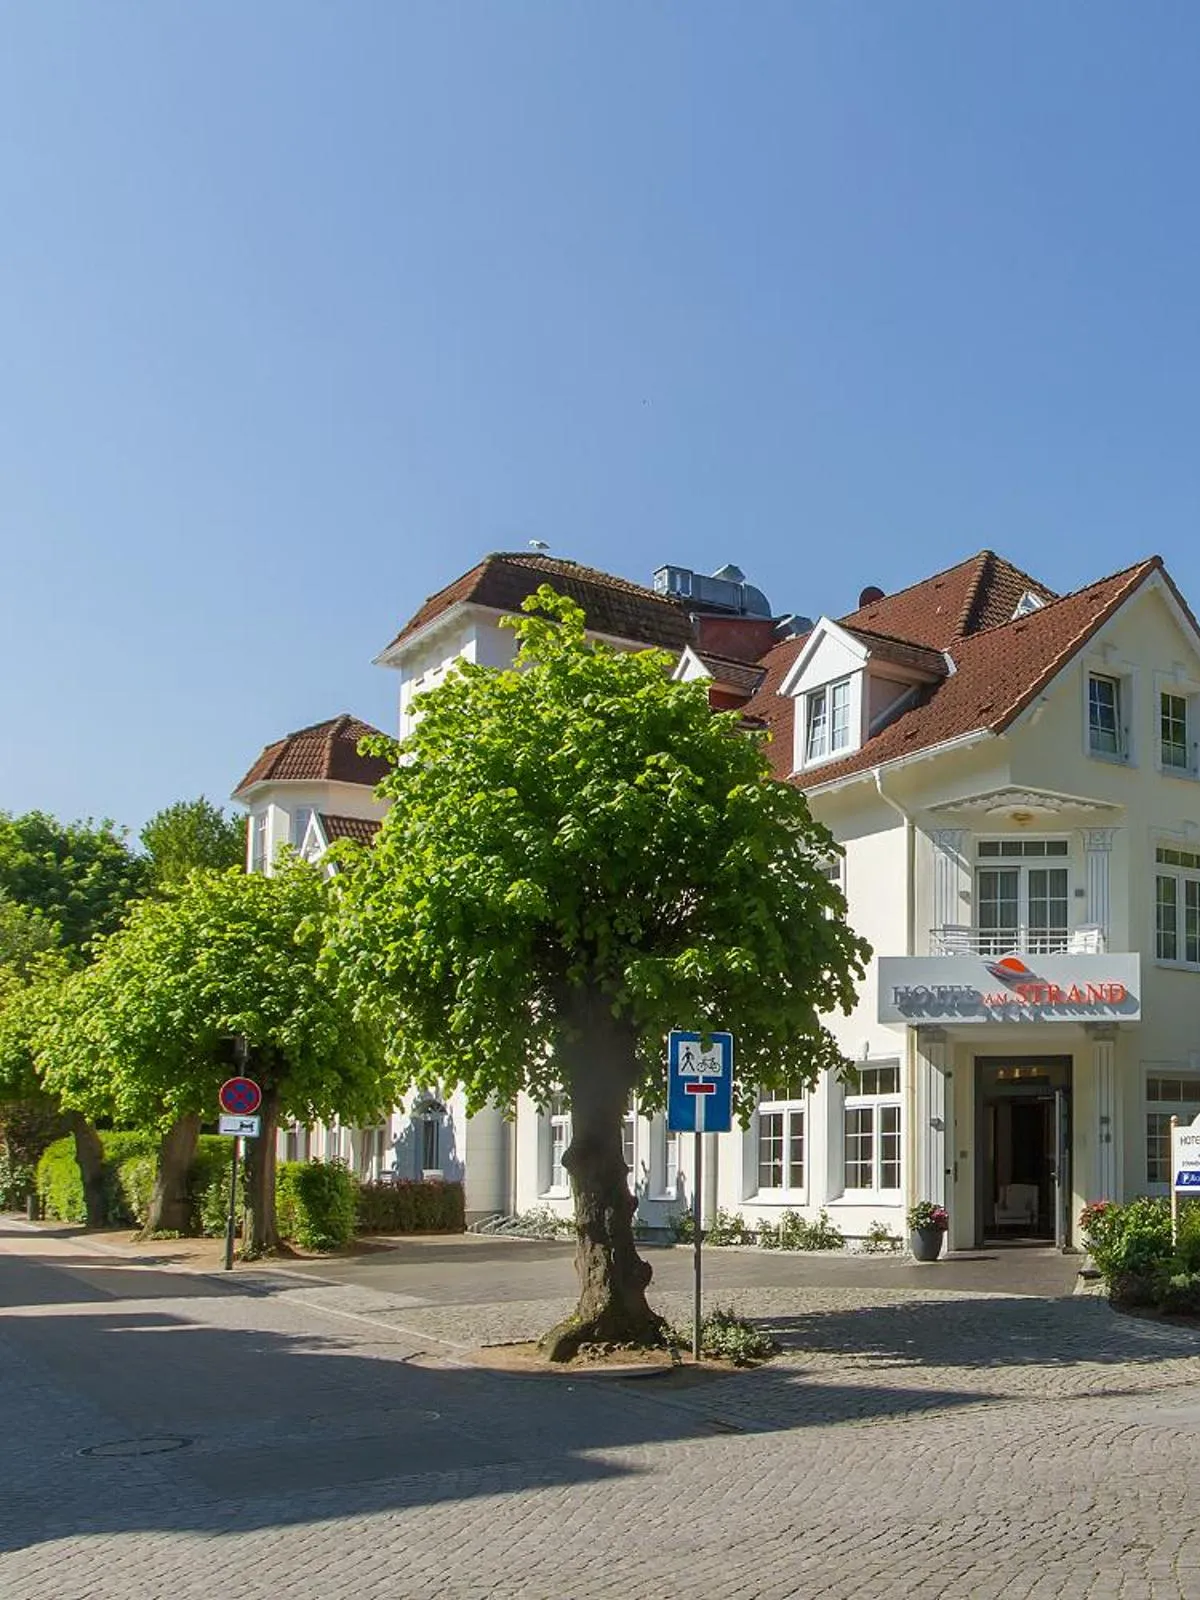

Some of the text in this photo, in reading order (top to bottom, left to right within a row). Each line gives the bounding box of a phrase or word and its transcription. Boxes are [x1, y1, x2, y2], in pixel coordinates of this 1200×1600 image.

[892, 983, 1127, 1006] HOTEL AM STRAND
